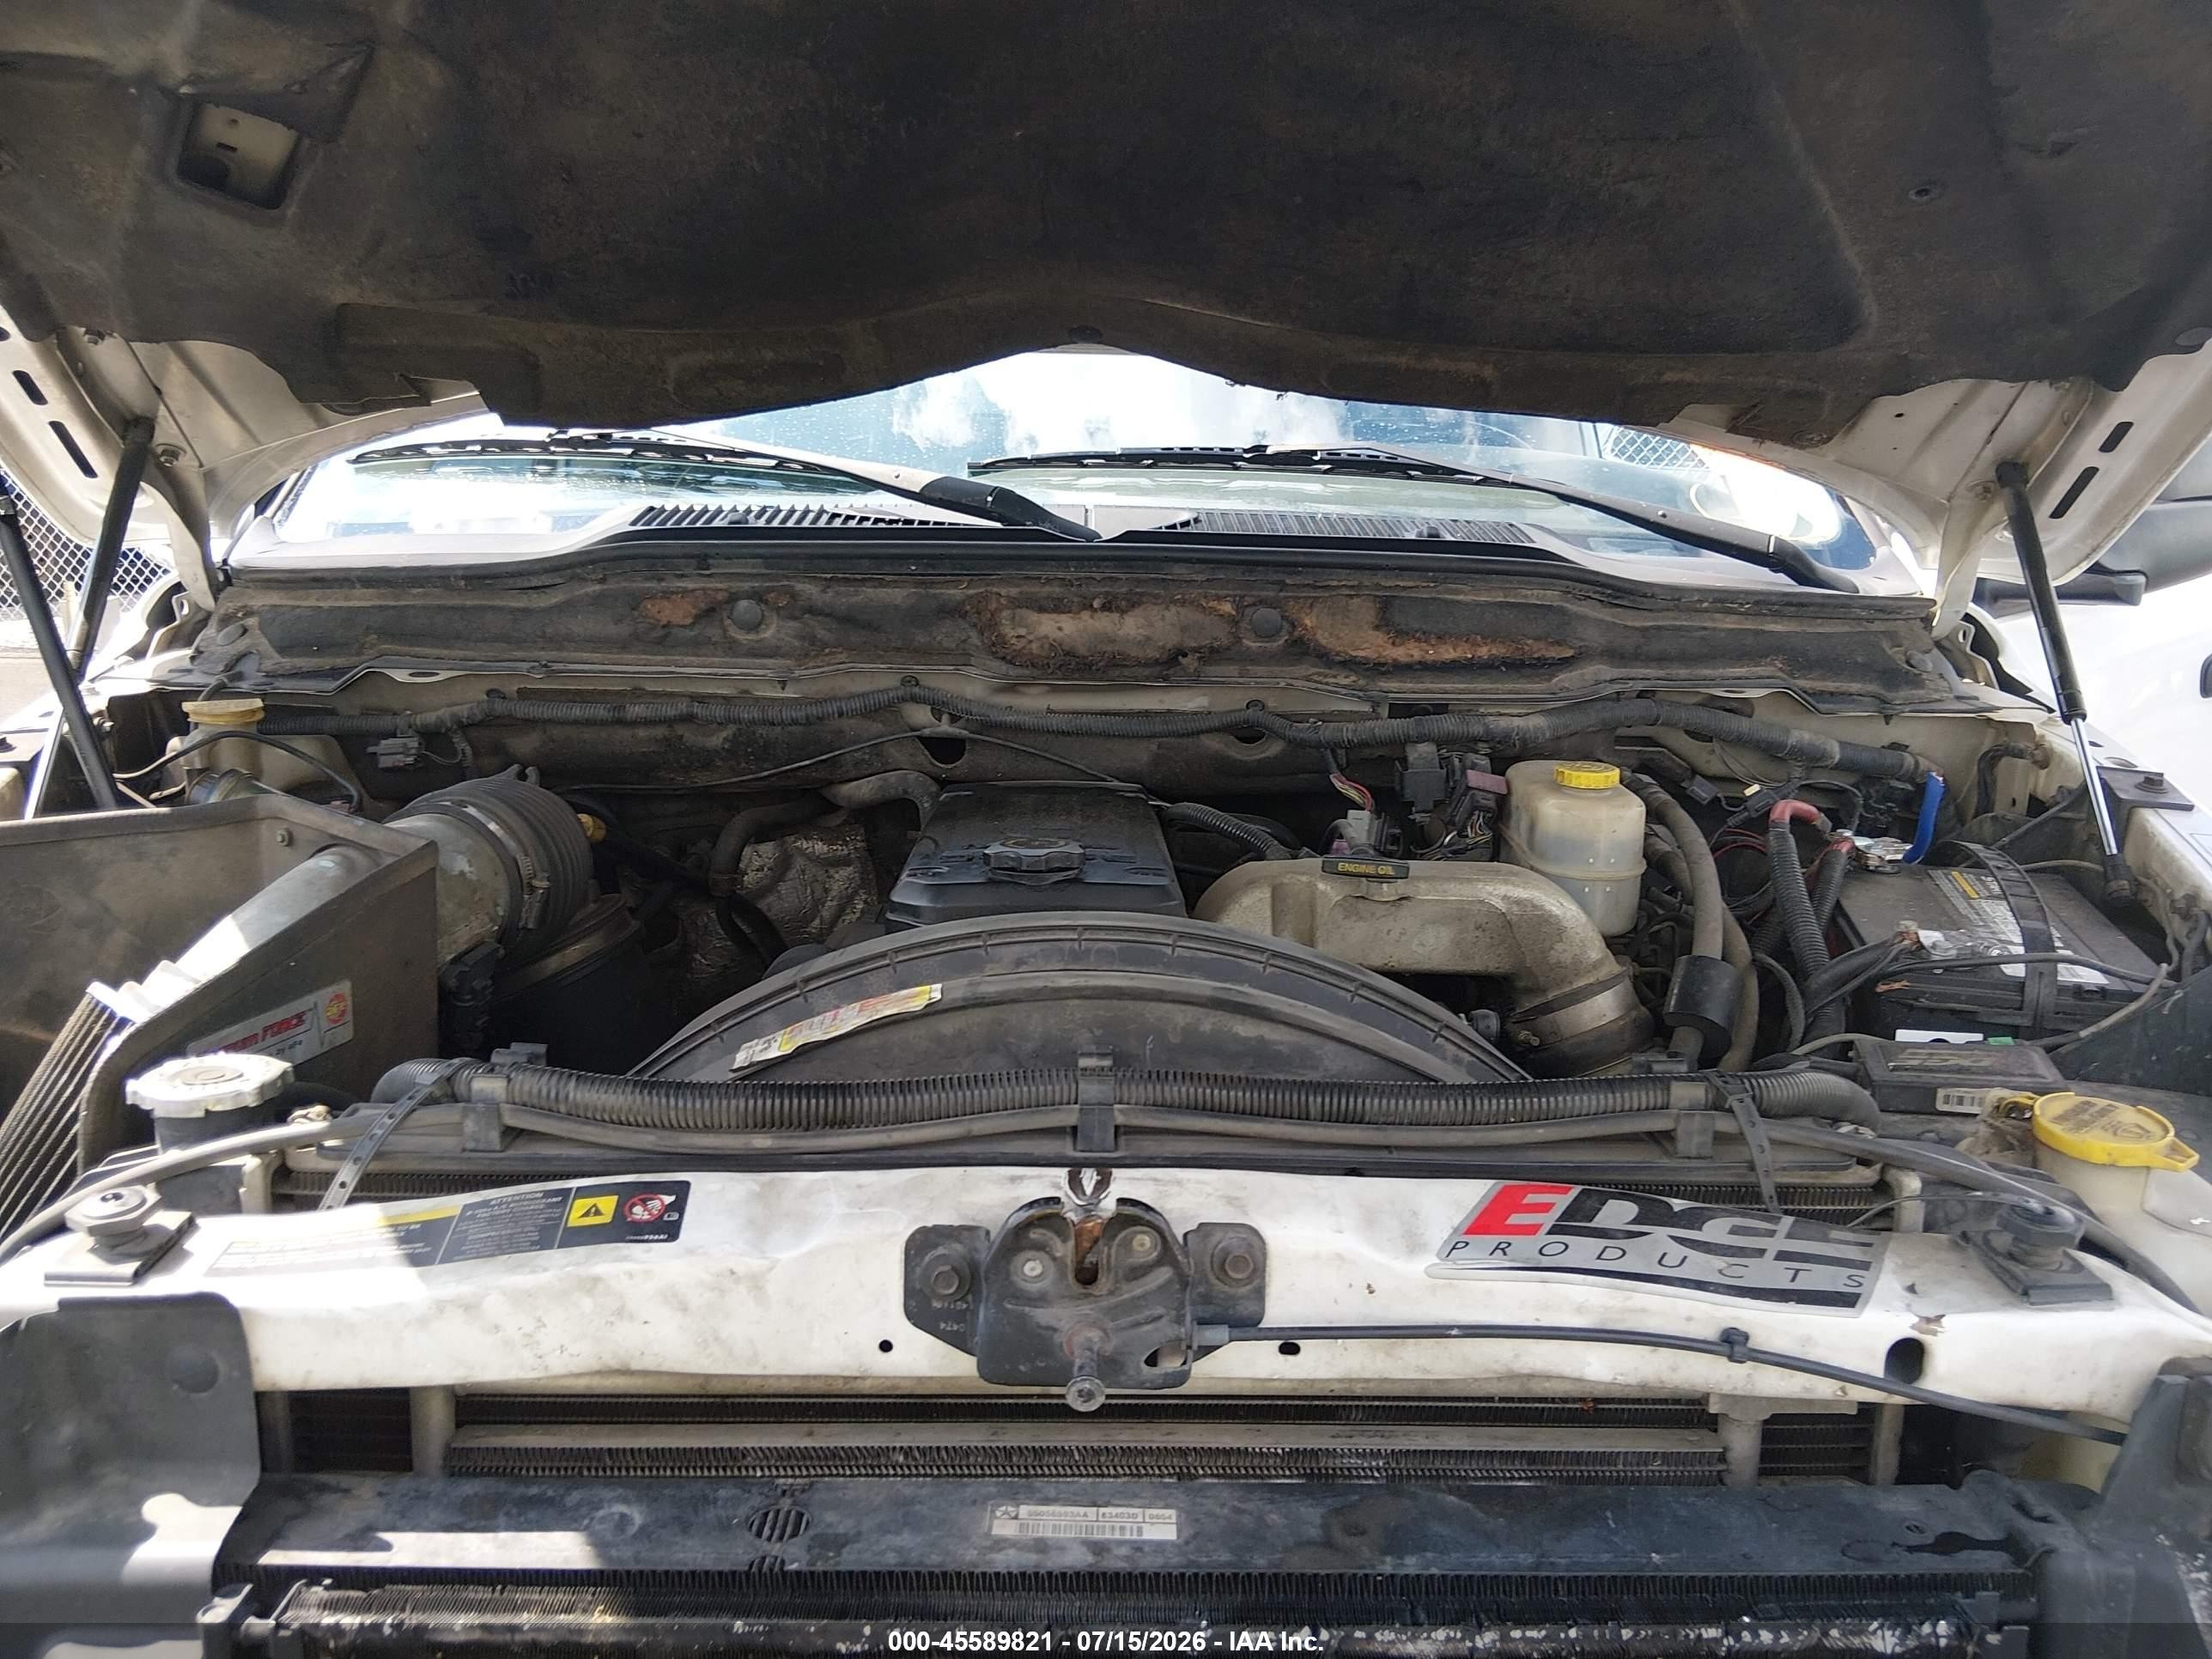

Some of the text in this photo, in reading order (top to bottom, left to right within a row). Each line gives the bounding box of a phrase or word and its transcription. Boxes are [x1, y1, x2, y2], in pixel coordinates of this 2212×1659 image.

[1337, 862, 1395, 875] ENGINE OIL
[489, 1192, 544, 1206] ATTENTION
[1463, 1182, 1891, 1271] EDGE
[1444, 1241, 1866, 1289] PRODUCTS
